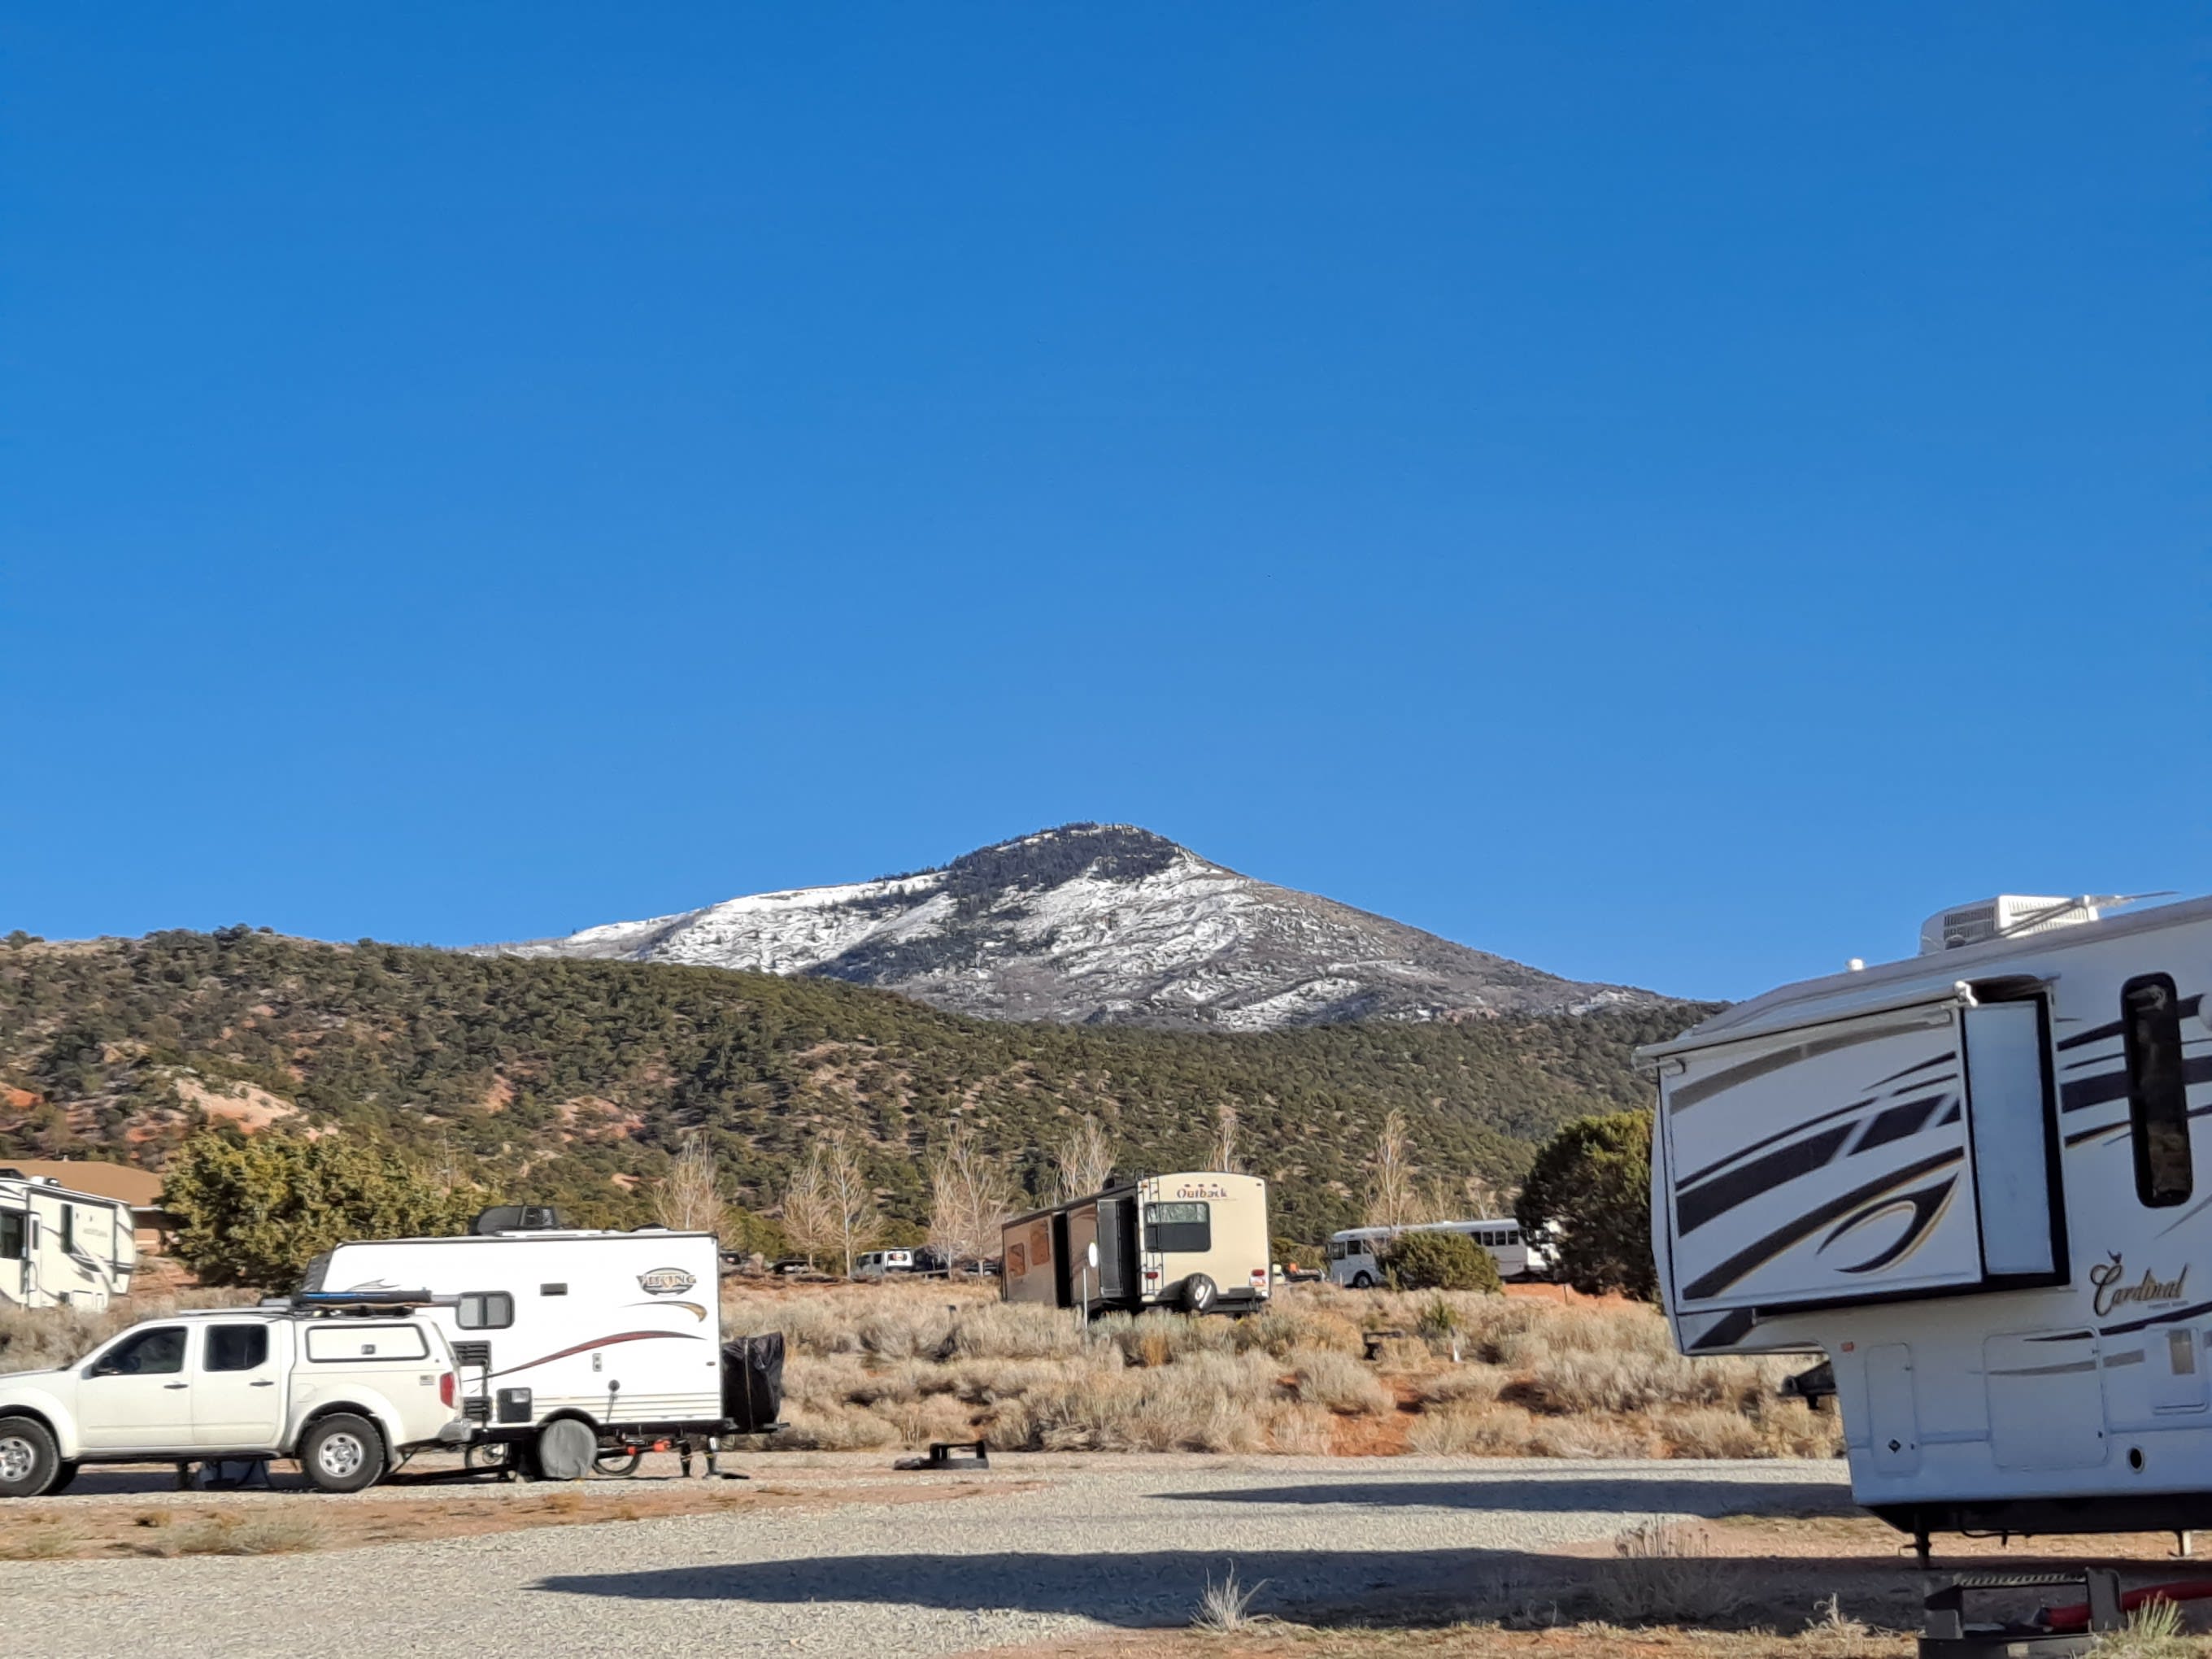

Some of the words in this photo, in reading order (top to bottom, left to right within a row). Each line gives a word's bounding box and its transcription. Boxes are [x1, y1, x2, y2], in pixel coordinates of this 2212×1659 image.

[1176, 1187, 1227, 1198] Outback
[635, 1274, 697, 1287] VIKING
[2089, 1262, 2188, 1317] Cardinal
